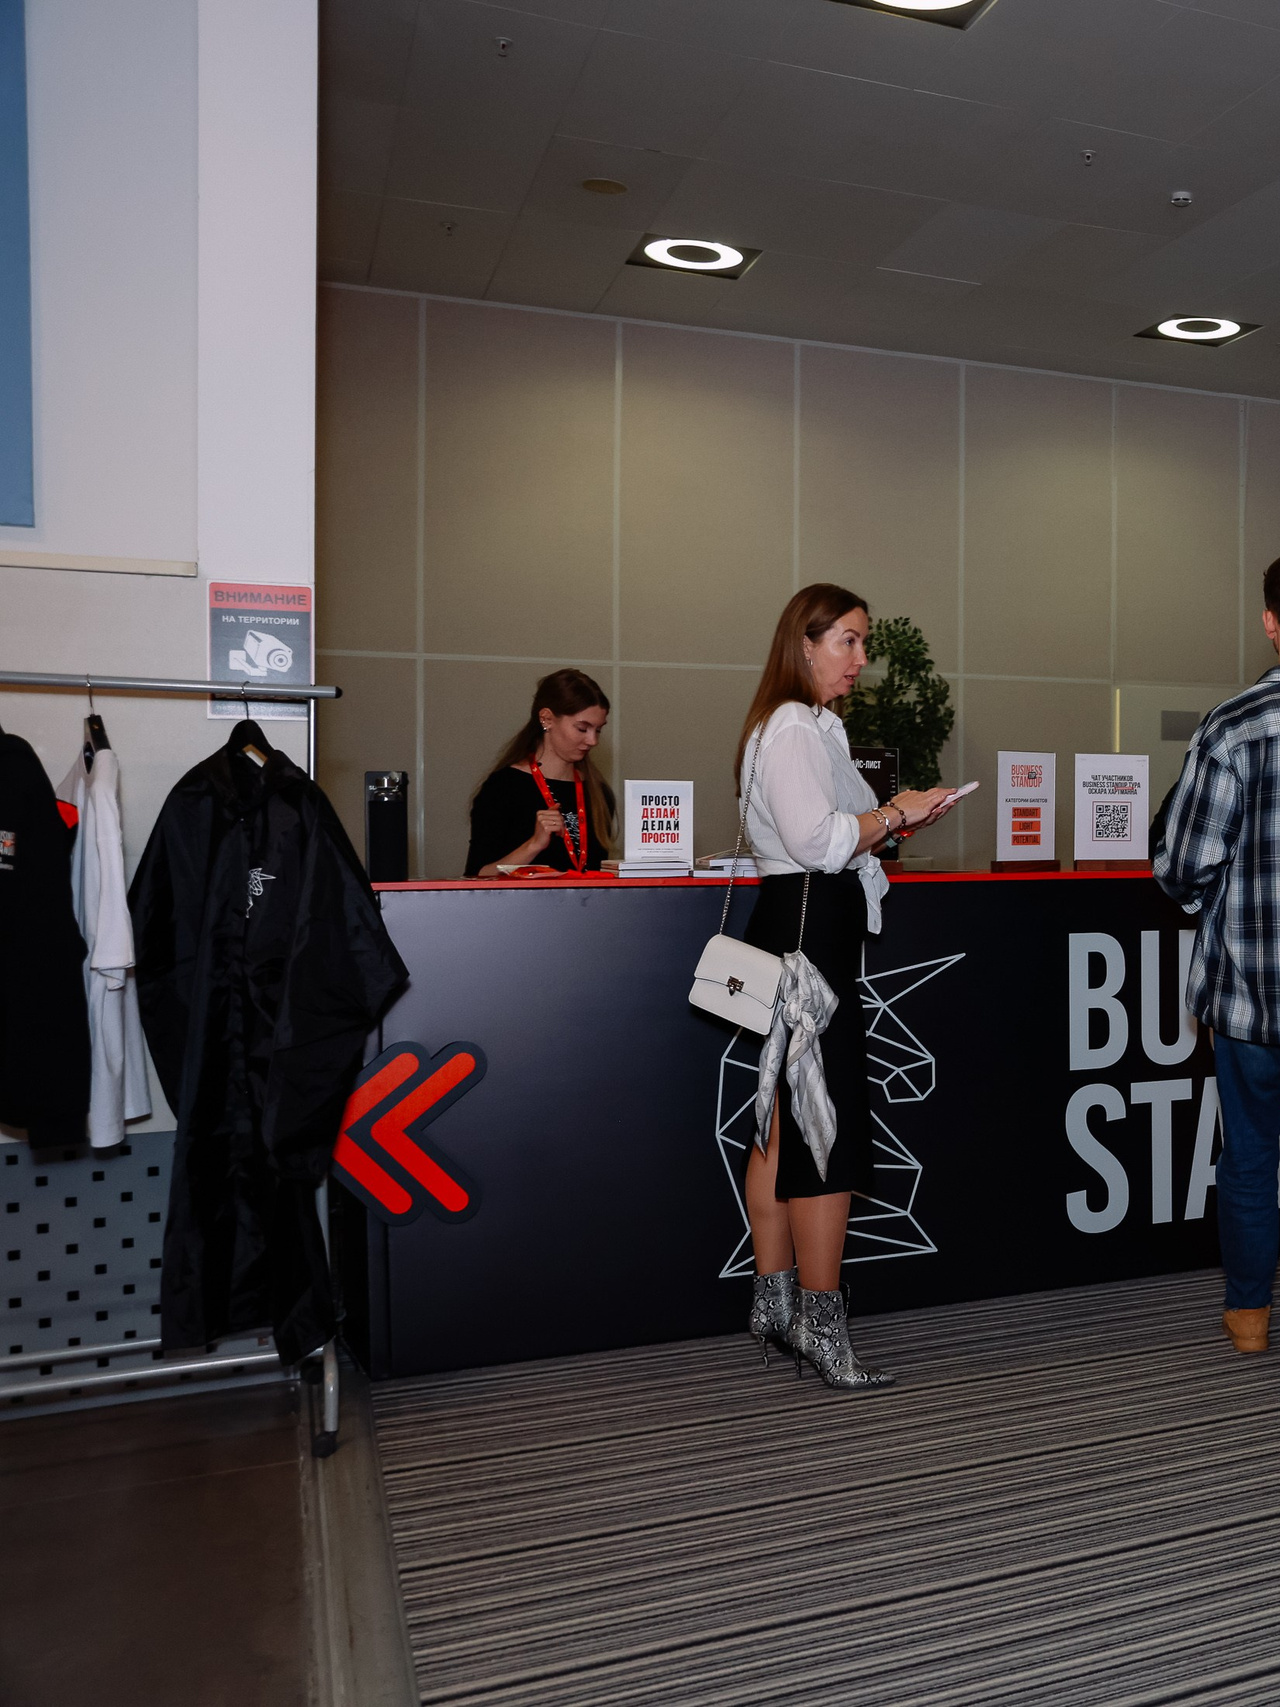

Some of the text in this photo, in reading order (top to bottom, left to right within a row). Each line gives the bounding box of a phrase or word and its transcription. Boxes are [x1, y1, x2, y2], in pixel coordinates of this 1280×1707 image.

[214, 590, 307, 605] ВНИМАНИЕ
[222, 615, 299, 625] НА ТЕРРИТОРИИ
[852, 759, 881, 769] ЙС-ЛИСТ
[1011, 764, 1043, 775] BUSINESS
[1011, 776, 1042, 787] STANDUP
[641, 795, 680, 806] ПРОСТО
[641, 806, 680, 819] ДЕЛАЙ!
[641, 819, 680, 832] ДЕЛАЙ
[641, 833, 680, 843] ПРОСТО!
